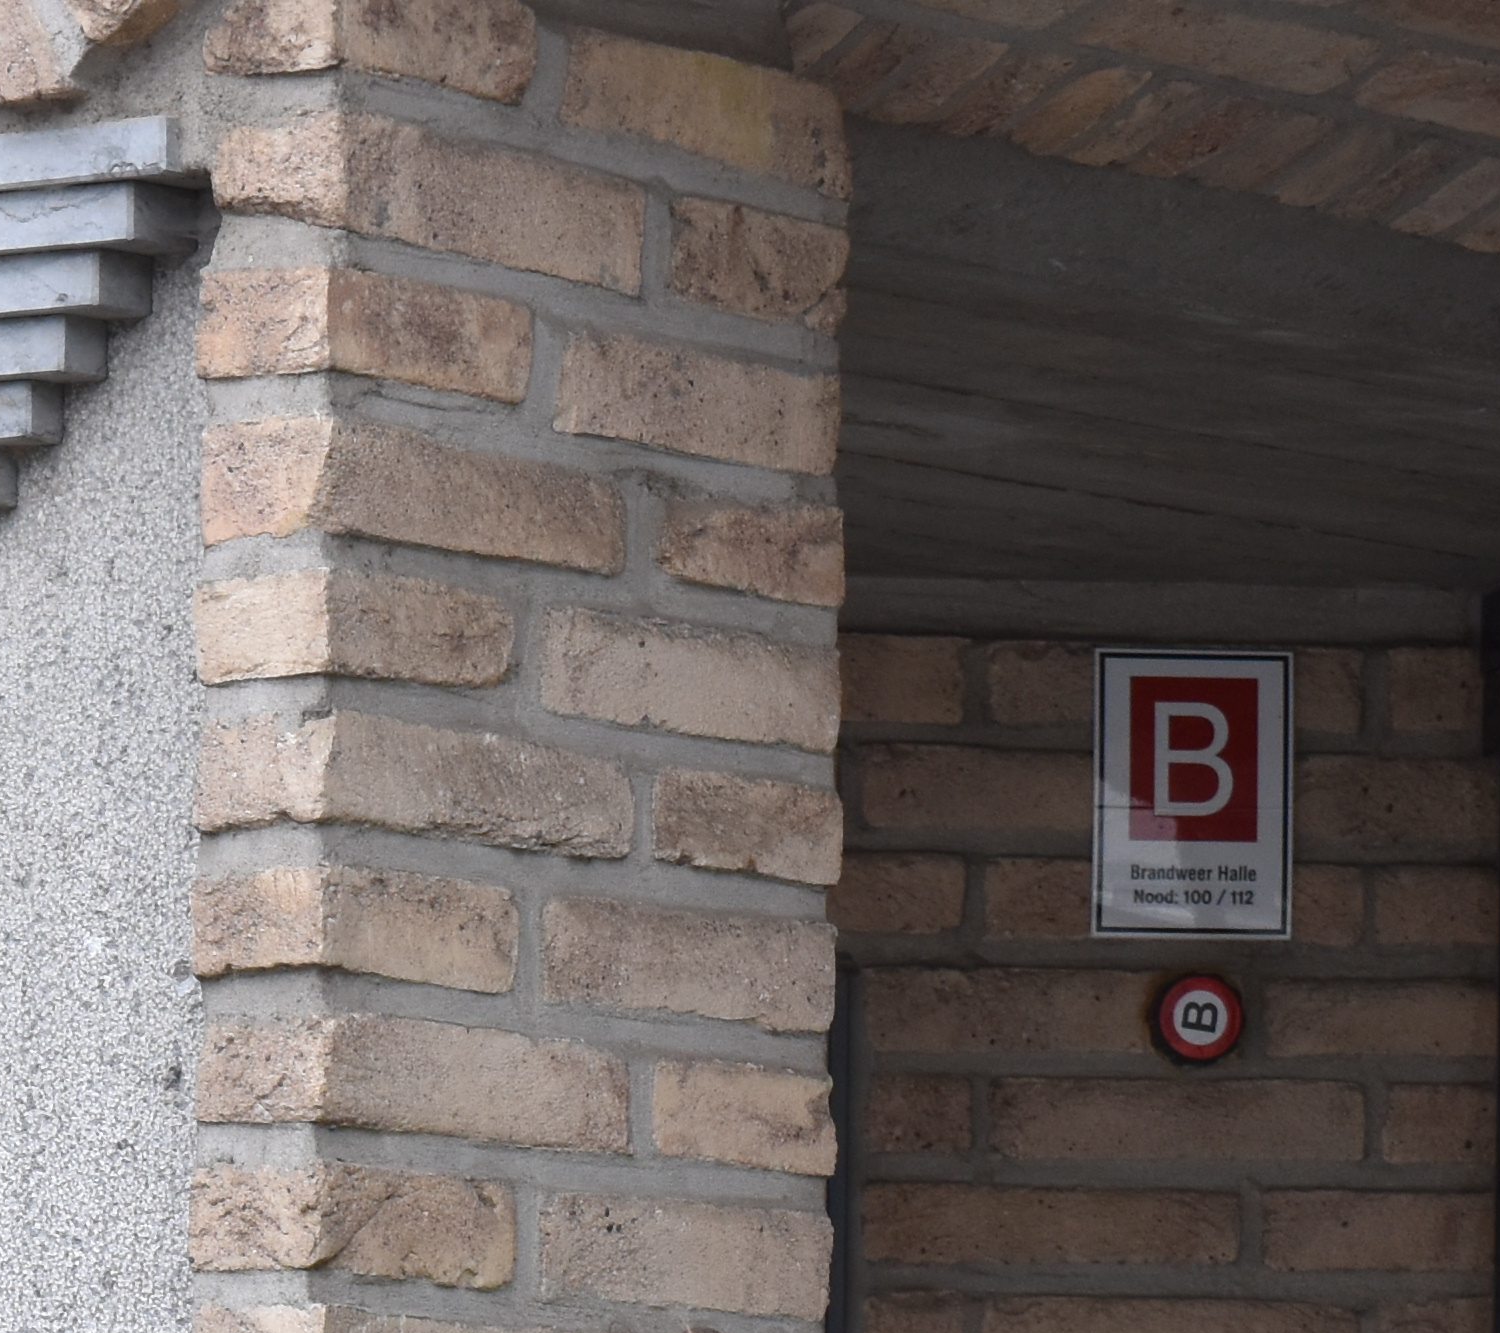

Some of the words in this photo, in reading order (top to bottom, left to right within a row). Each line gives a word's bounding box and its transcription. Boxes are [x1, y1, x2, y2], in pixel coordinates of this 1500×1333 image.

[1154, 702, 1234, 817] B
[1130, 864, 1212, 882] Brandweer
[1217, 865, 1257, 883] Halle
[1183, 890, 1213, 906] 100
[1230, 890, 1255, 906] 112
[1182, 1001, 1219, 1033] B
